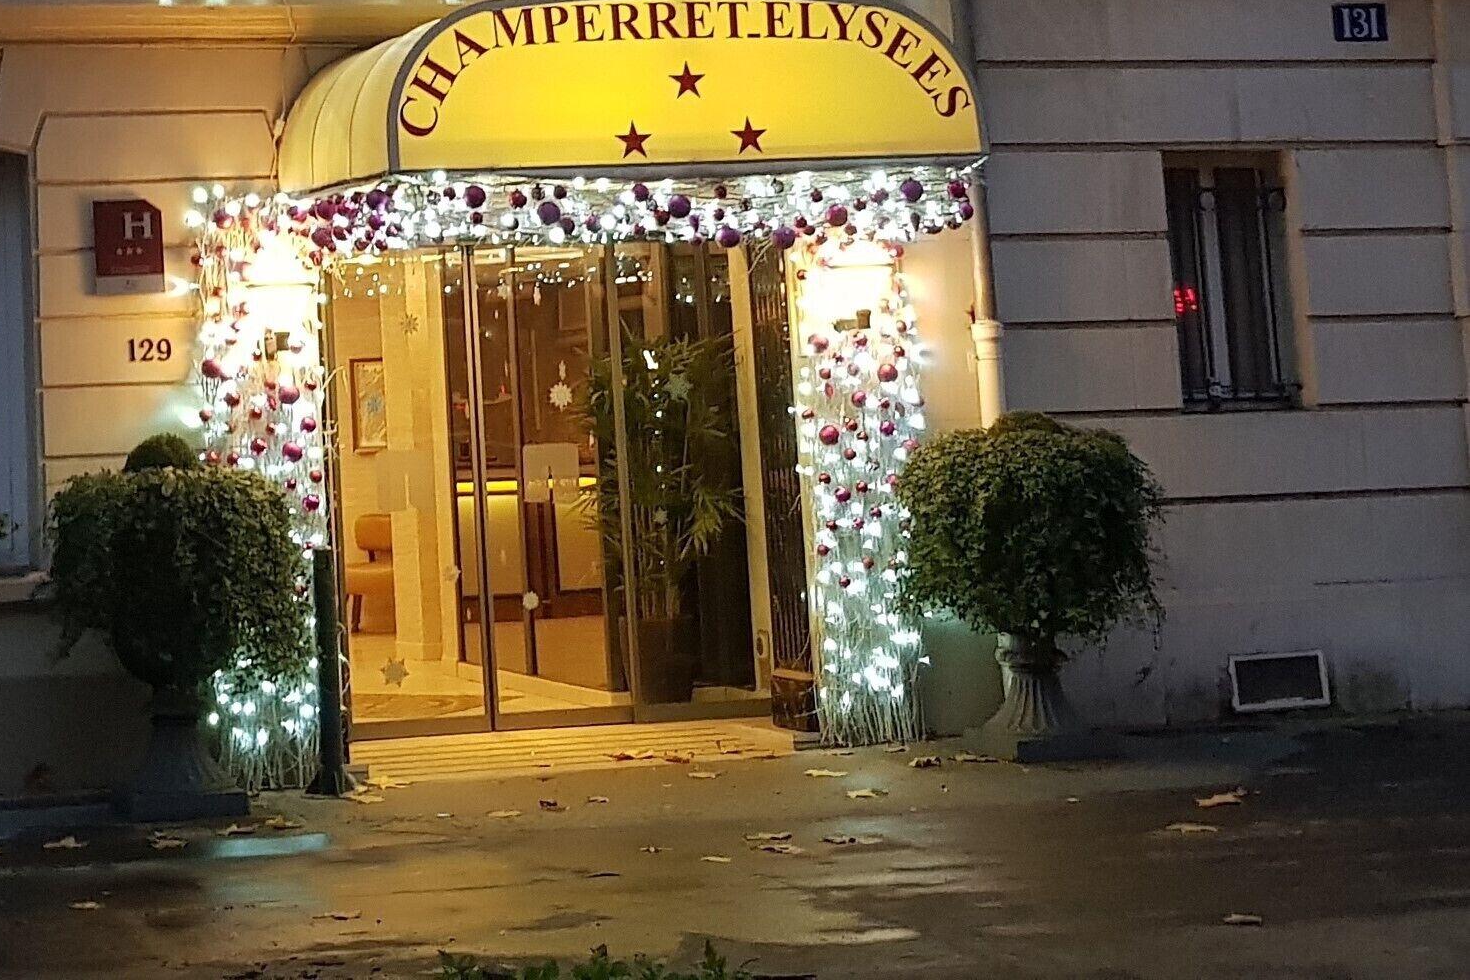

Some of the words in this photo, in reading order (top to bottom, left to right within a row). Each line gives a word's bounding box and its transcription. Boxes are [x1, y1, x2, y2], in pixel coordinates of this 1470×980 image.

[1341, 8, 1380, 38] 131
[123, 211, 153, 240] H
[128, 338, 172, 362] 129
